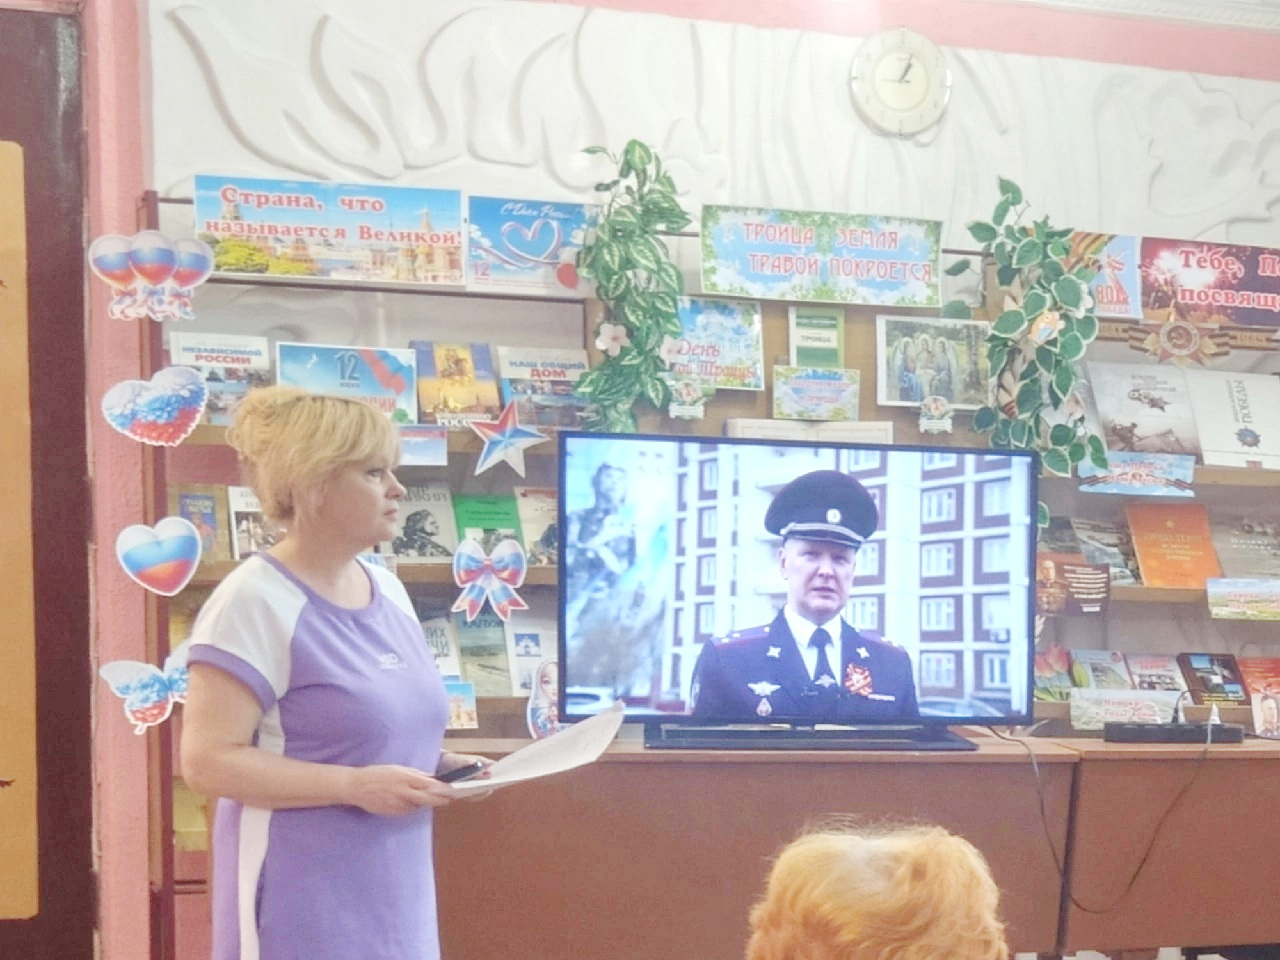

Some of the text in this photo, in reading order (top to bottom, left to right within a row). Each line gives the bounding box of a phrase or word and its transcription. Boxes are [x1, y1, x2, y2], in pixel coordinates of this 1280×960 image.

[220, 186, 385, 213] Страна, что
[205, 220, 463, 245] называется Великой!
[743, 222, 898, 249] ТРОИЦА ЗЕМЛЯ
[748, 253, 932, 281] ТРАВОЙ ПОКРОЕТСЯ
[1180, 246, 1245, 278] Тебе,
[194, 354, 251, 365] РОССИИ
[677, 339, 720, 356] День
[335, 350, 360, 380] 12
[530, 368, 567, 379] ДОМ
